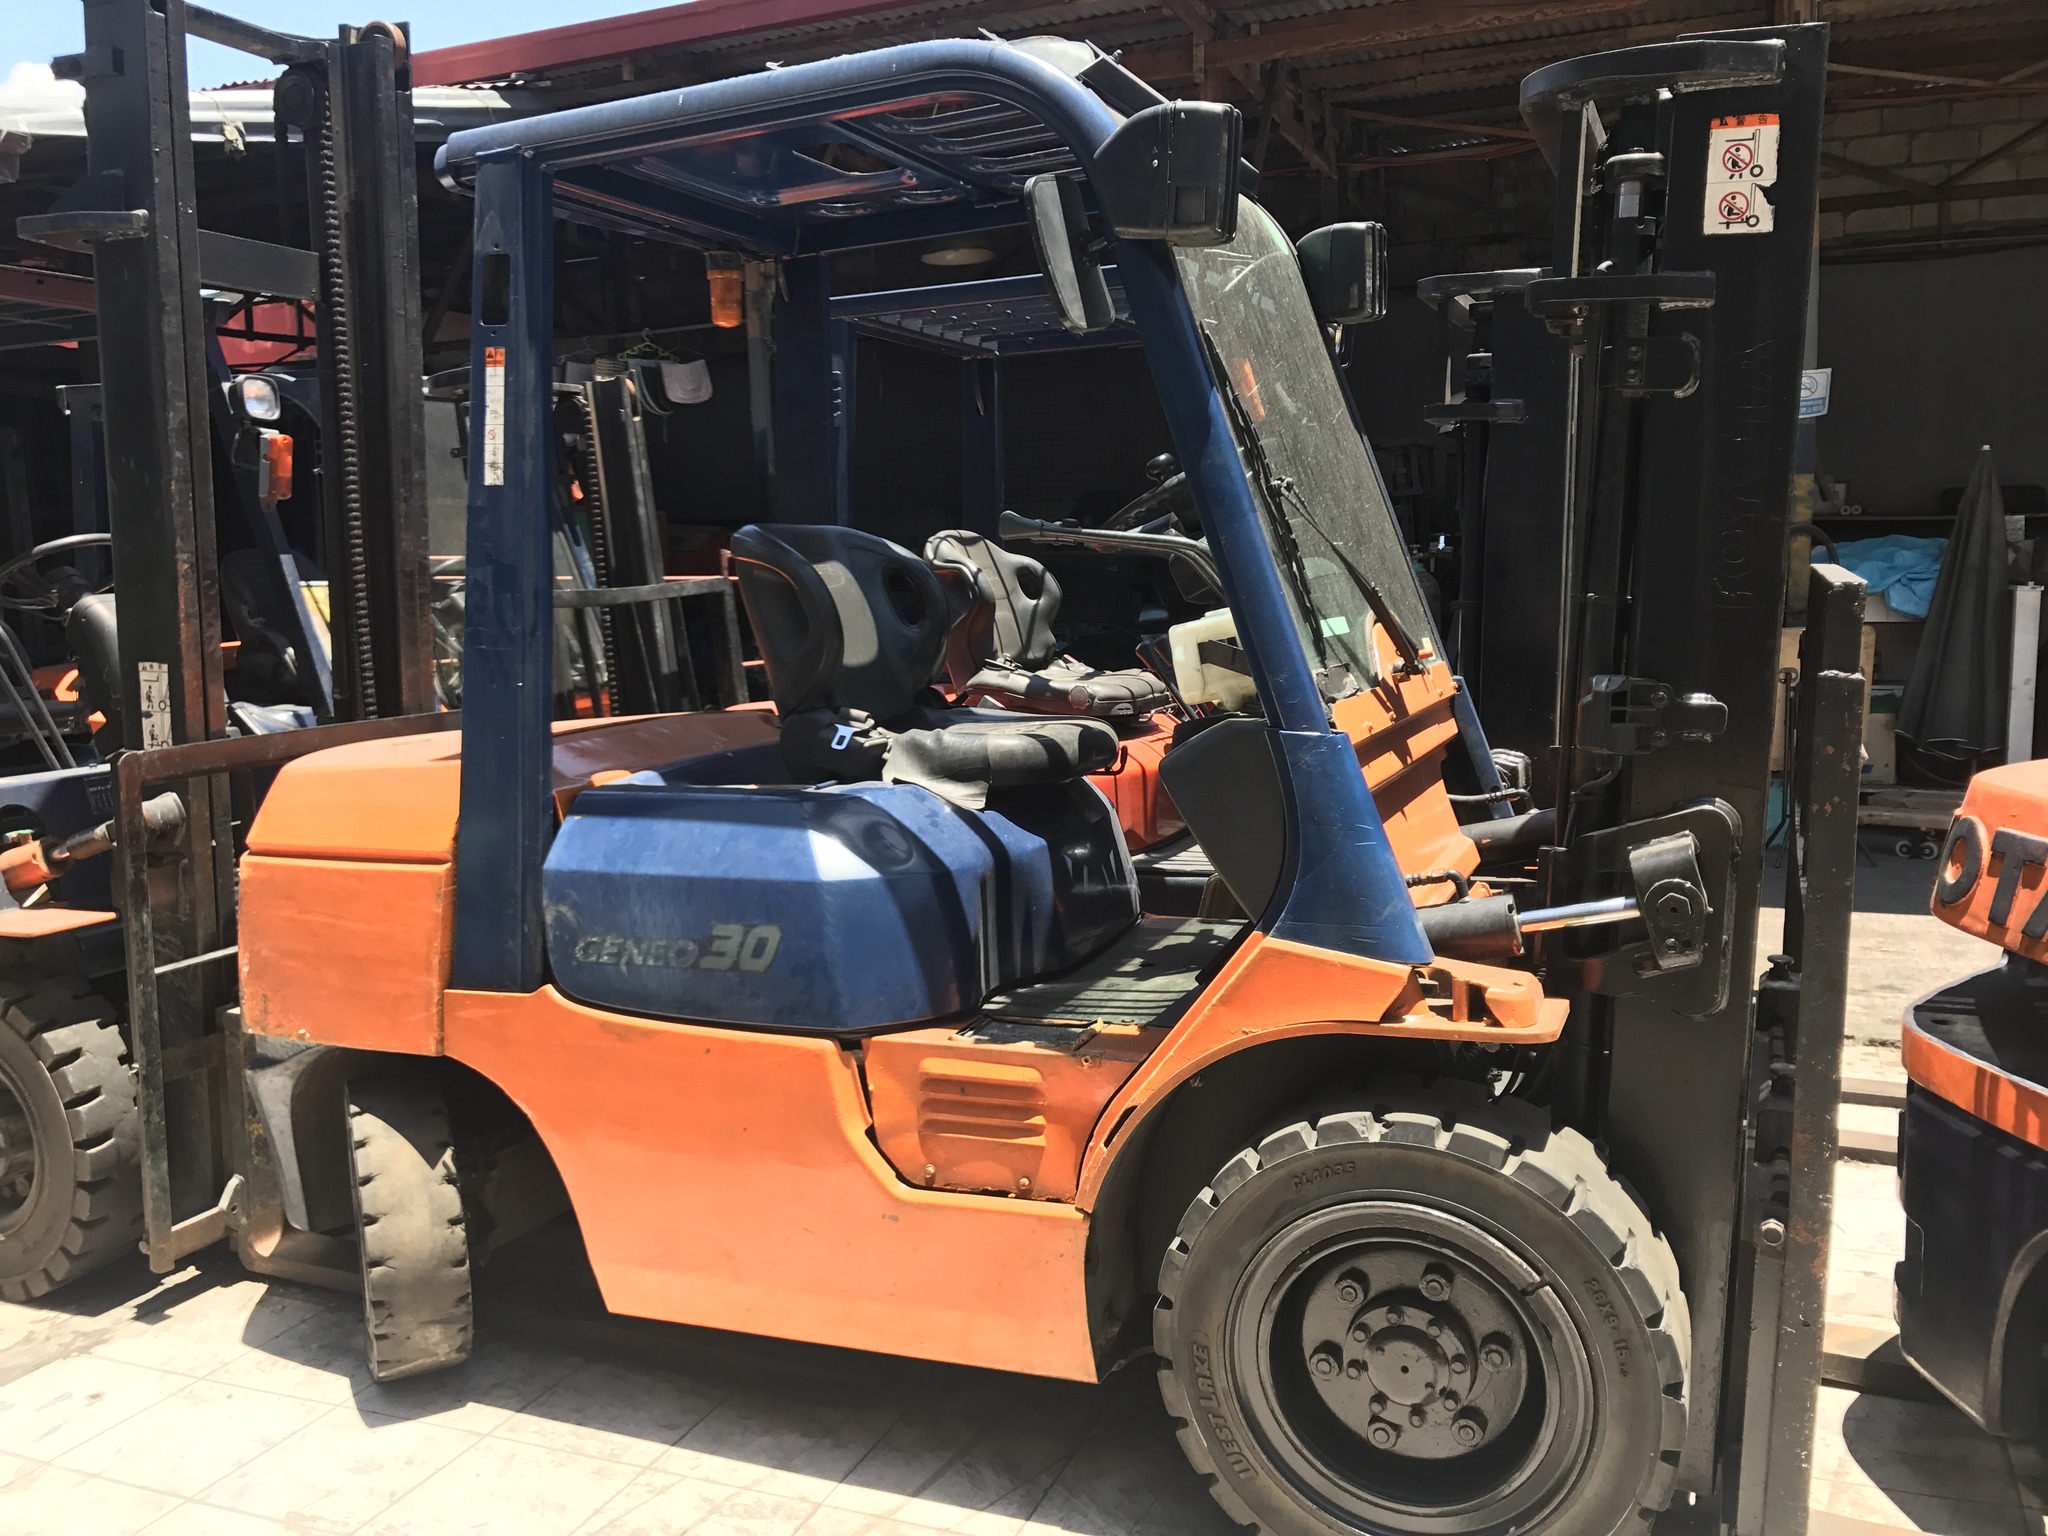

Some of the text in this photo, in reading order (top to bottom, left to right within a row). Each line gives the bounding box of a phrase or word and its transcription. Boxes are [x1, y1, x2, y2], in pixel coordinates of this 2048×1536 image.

[1711, 338, 1775, 609] TOYOTA
[574, 924, 782, 973] GENEO 30
[1192, 1343, 1259, 1480] WEST LAKE
